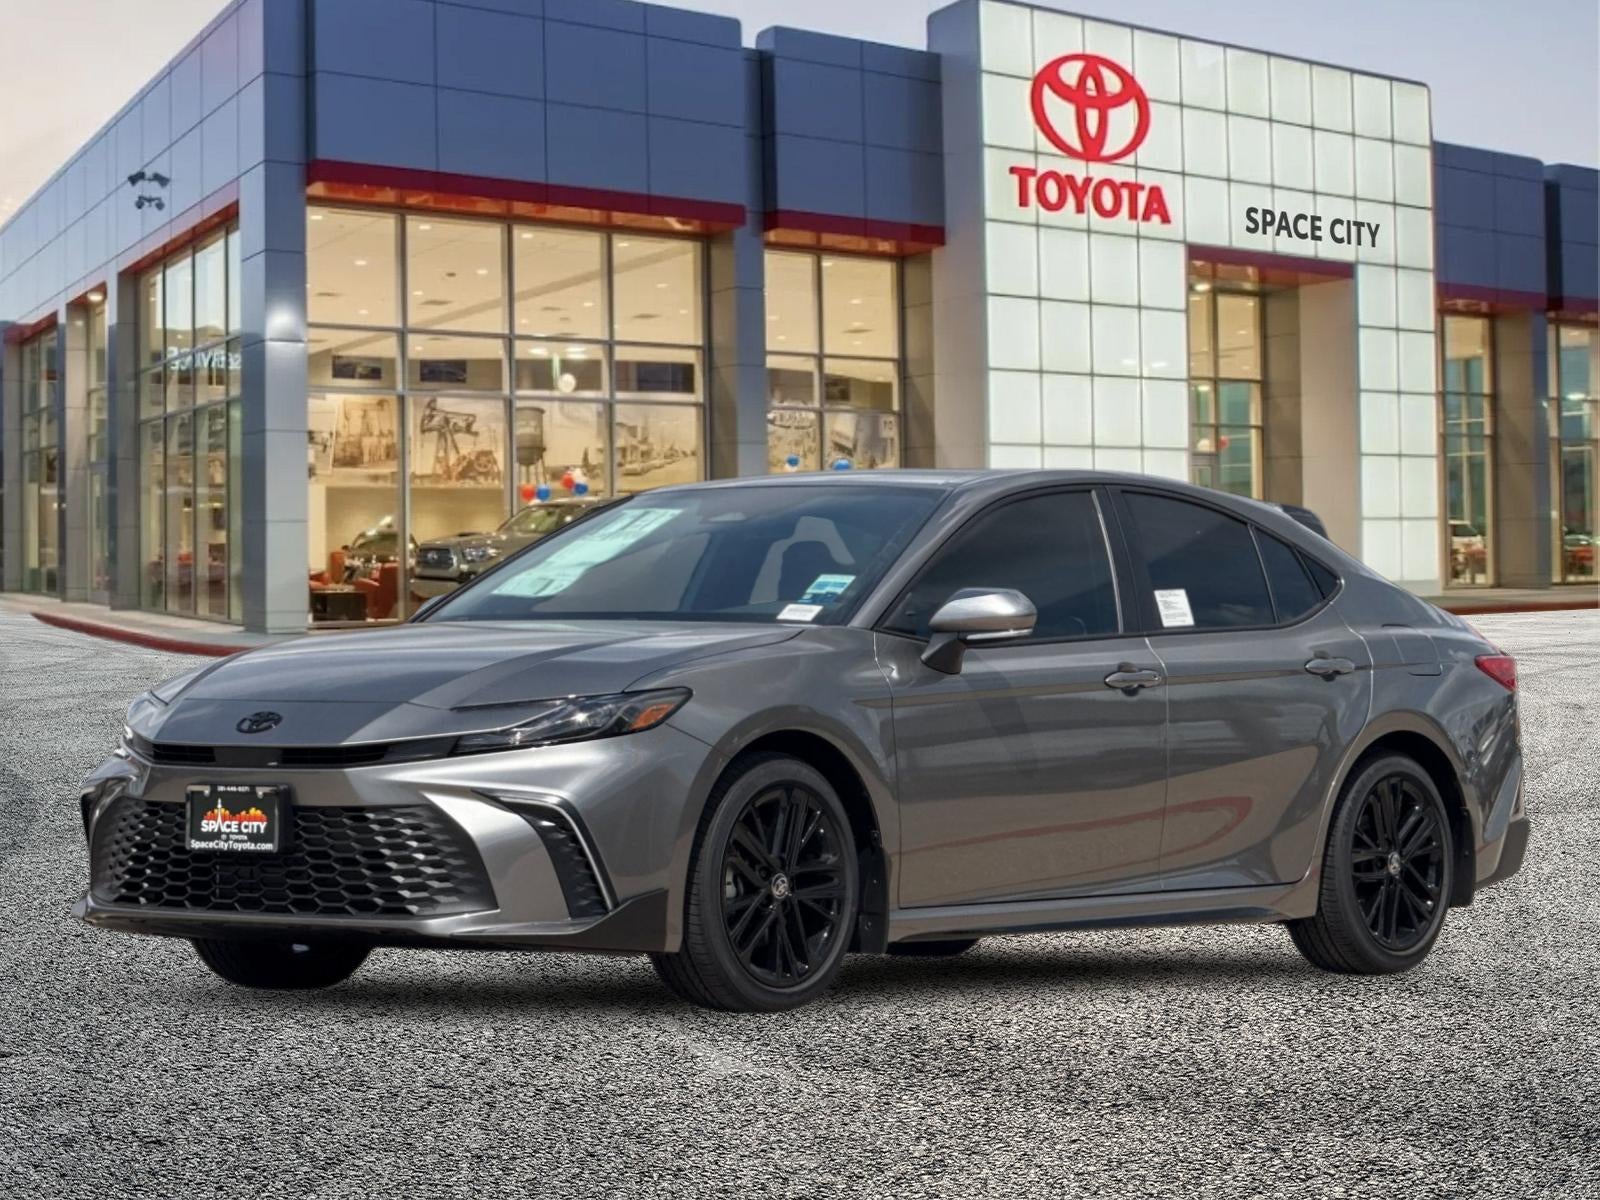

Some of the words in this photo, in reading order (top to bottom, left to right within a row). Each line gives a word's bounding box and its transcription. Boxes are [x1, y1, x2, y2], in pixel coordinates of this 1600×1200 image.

[1009, 166, 1171, 225] TOYOTA
[1245, 206, 1322, 242] SPACE
[1329, 218, 1381, 248] CITY
[201, 820, 239, 832] SPACE
[241, 822, 267, 833] CITY
[190, 840, 273, 851] SpaceCityToyota.com
